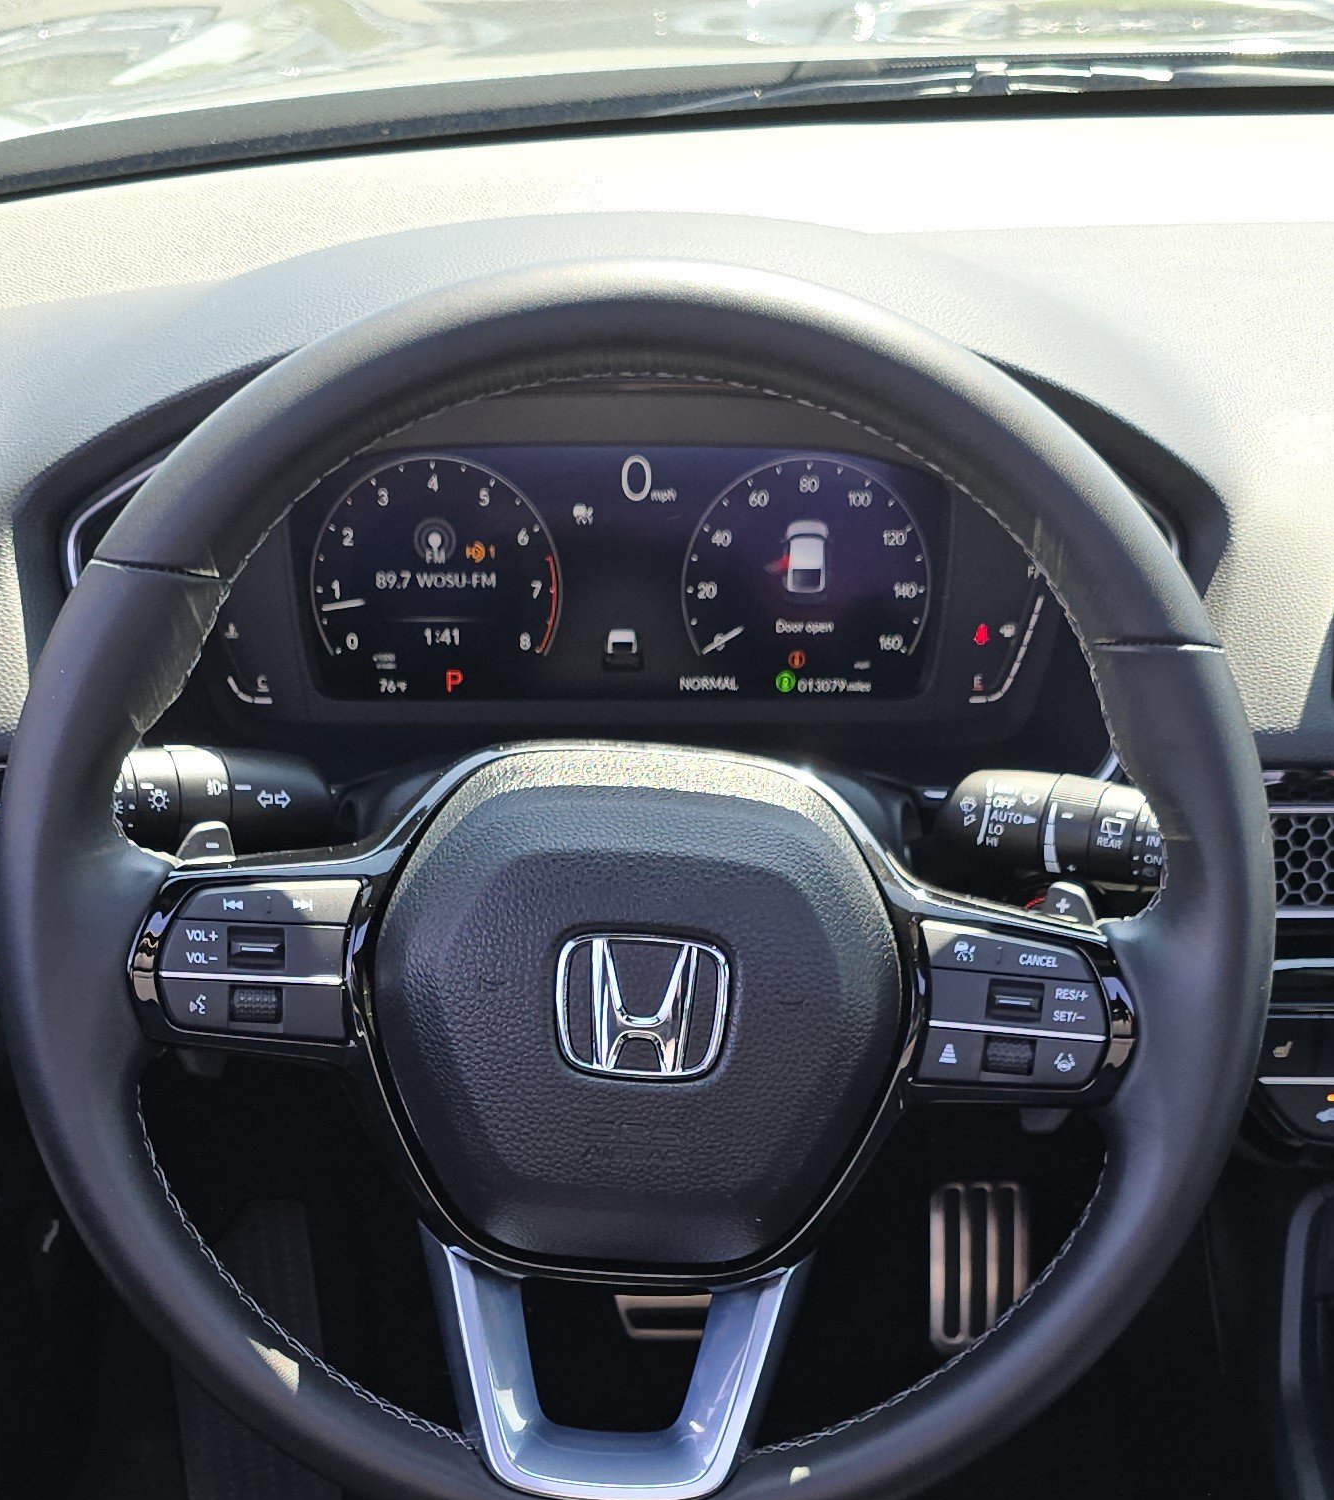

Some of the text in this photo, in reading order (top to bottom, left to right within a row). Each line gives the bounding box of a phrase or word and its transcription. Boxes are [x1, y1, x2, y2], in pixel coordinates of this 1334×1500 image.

[427, 473, 439, 492] 4
[621, 454, 678, 504] 0 mph
[799, 474, 820, 493] 80
[377, 487, 389, 507] 3
[479, 486, 491, 507] 5
[748, 489, 769, 508] 60
[848, 489, 872, 507] 100
[342, 527, 354, 547] 2
[517, 527, 529, 546] 6
[711, 529, 733, 548] 40
[883, 529, 907, 546] 120
[425, 549, 446, 564] FM
[375, 570, 497, 590] 89.7 WOSU-FM
[331, 579, 341, 600] 1
[530, 580, 543, 600] 7
[697, 581, 718, 600] 20
[893, 582, 917, 599] 140
[775, 618, 834, 635] Door open
[346, 632, 359, 650] 0
[423, 627, 461, 647] 1:41
[519, 632, 532, 650] 8
[878, 633, 903, 650] 160
[445, 669, 464, 692] P
[679, 675, 739, 692] NORMAL
[797, 677, 847, 694] 013079
[993, 796, 1017, 811] OFF
[990, 811, 1023, 825] AUTO
[987, 824, 1005, 836] LO
[1096, 836, 1123, 850] REAR
[1019, 953, 1058, 968] CANCEL
